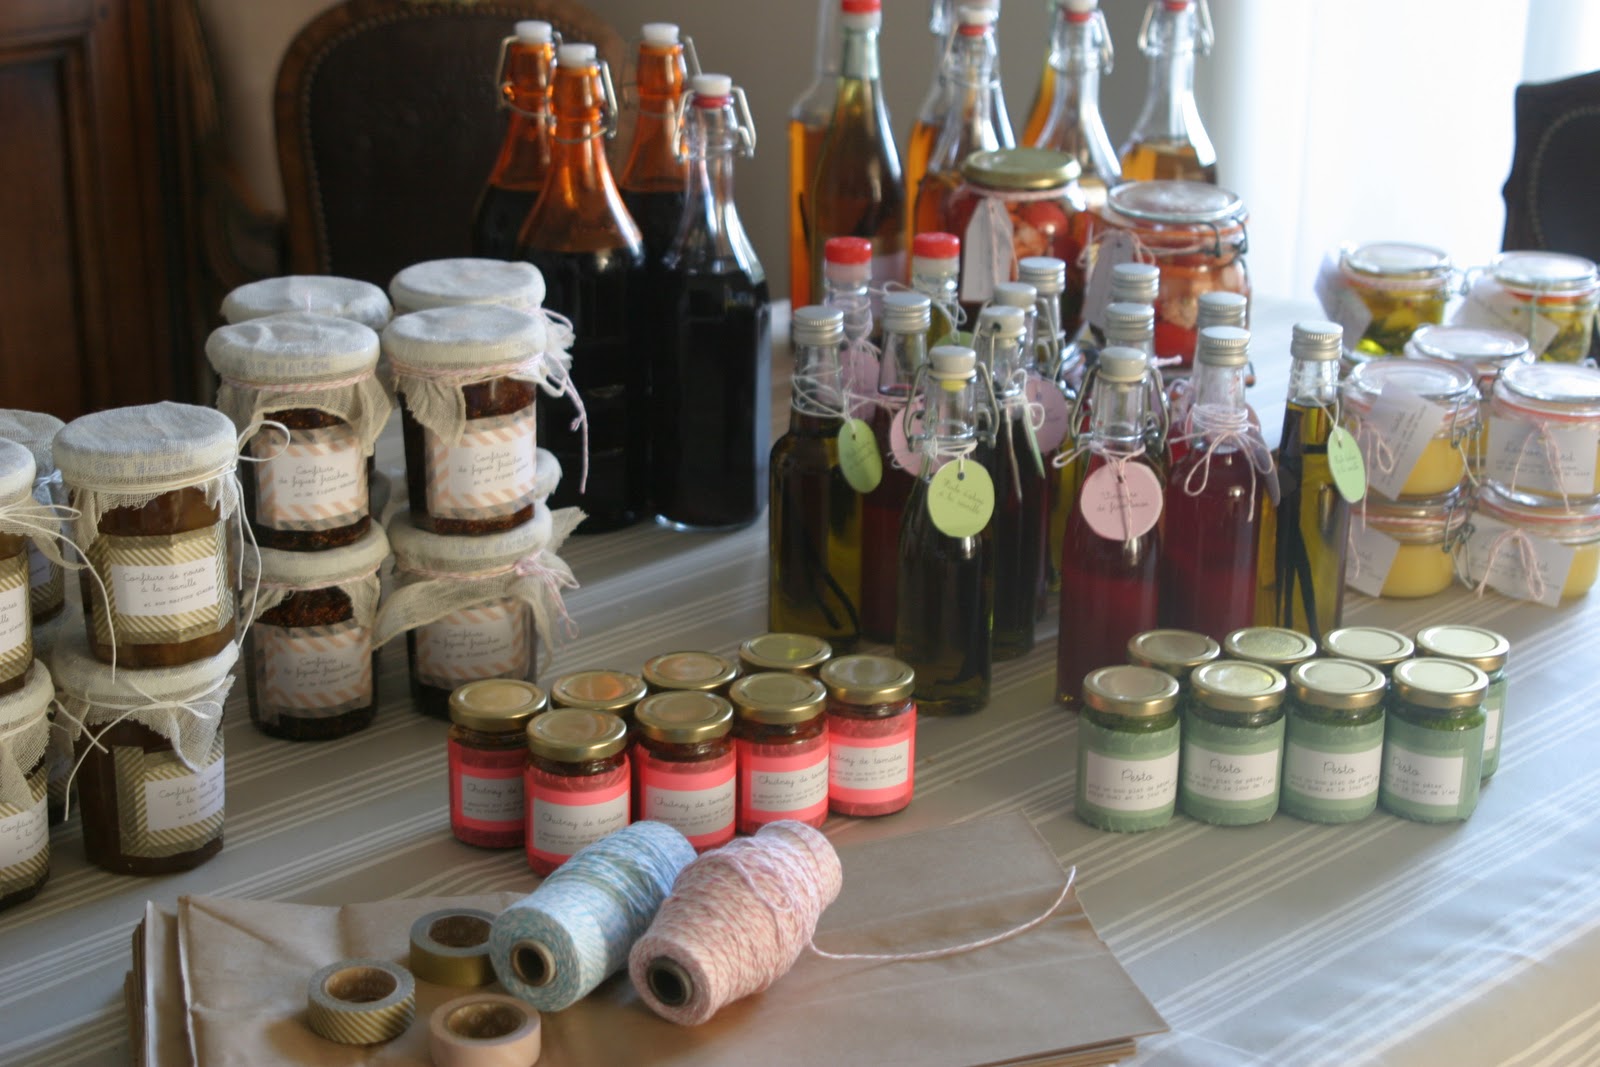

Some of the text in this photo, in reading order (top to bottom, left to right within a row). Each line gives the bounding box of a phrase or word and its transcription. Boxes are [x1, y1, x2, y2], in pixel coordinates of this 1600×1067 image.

[123, 572, 165, 585] Confiture
[1209, 758, 1241, 774] Pesto
[1323, 761, 1356, 774] Pesto
[758, 775, 794, 788] Chutney
[1121, 768, 1153, 782] Pesto
[655, 796, 690, 813] Chutney
[542, 812, 578, 831] Chutney
